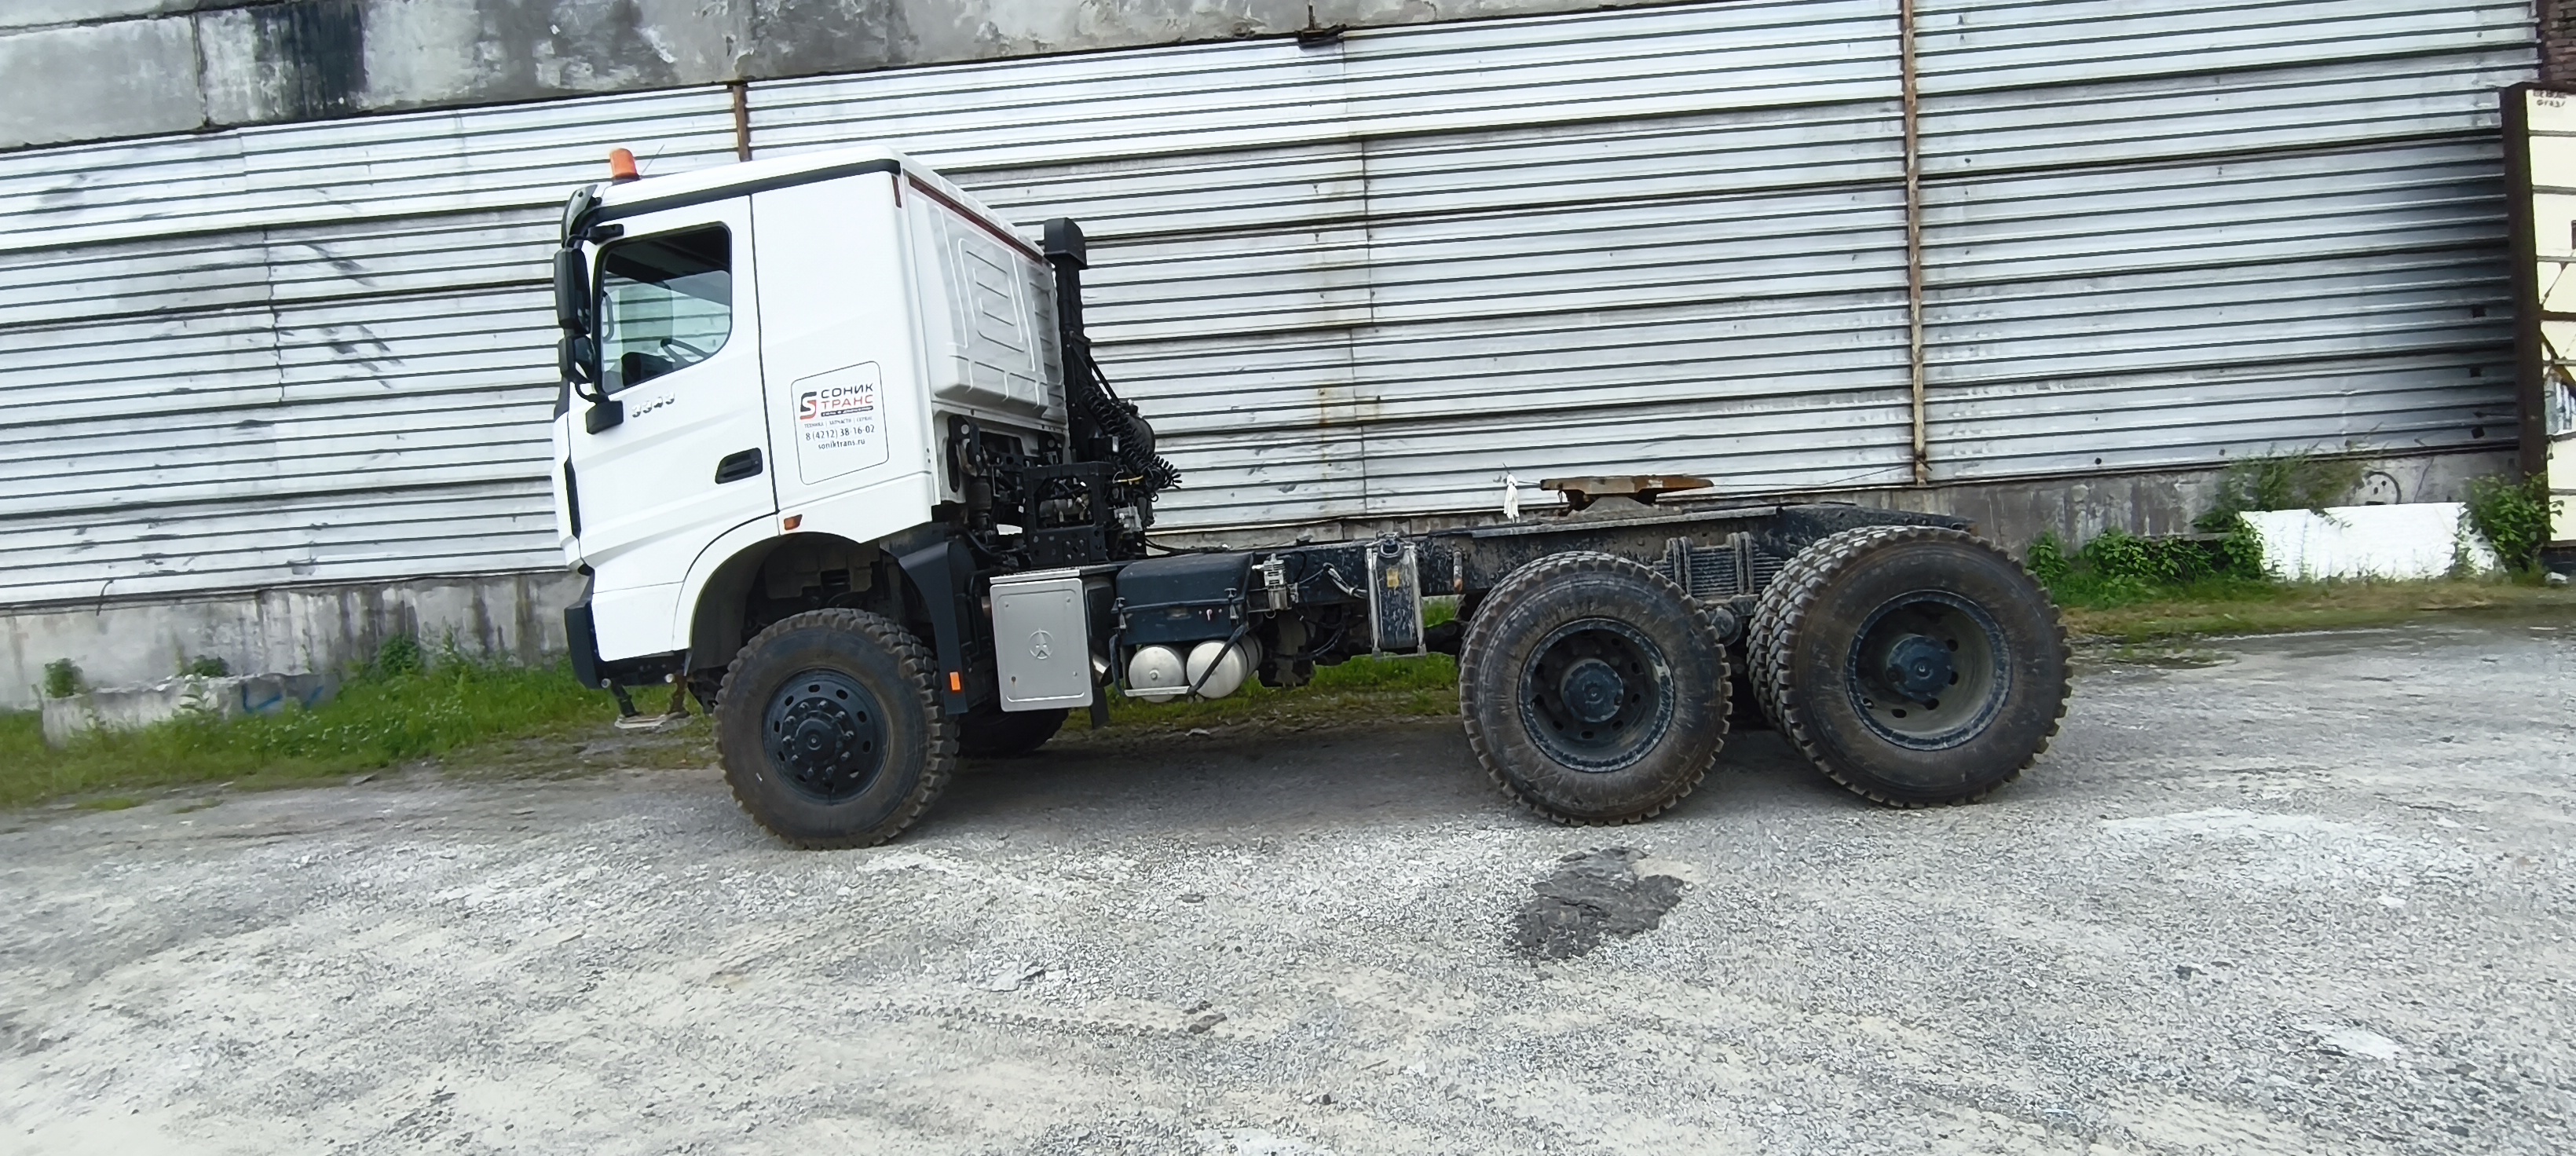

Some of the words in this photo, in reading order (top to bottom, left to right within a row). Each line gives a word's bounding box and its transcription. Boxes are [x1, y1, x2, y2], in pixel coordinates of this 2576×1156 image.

[821, 383, 873, 399] СОНИК
[821, 394, 873, 410] ТРАНС
[812, 429, 838, 441] (4212)
[840, 424, 875, 437] 38-16-02
[818, 438, 865, 450] soniktrans.ru
